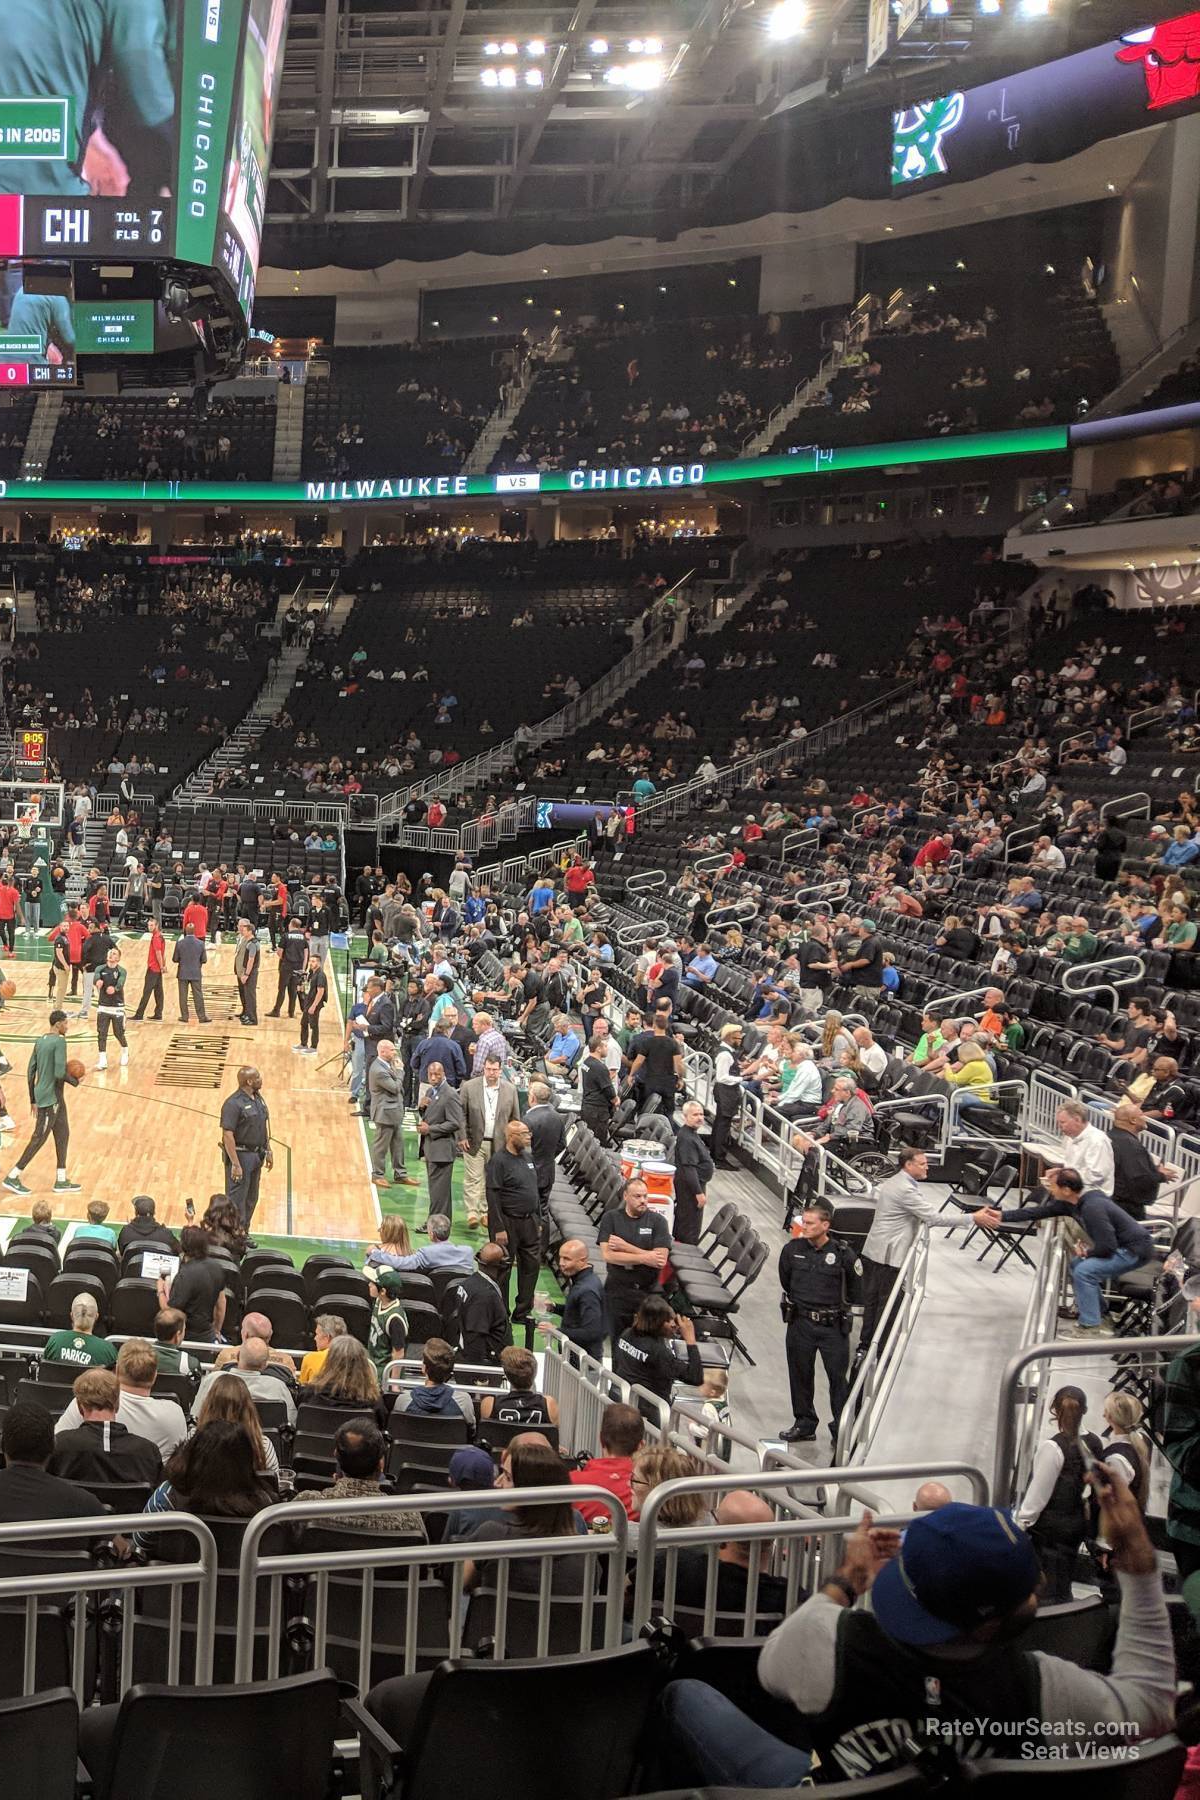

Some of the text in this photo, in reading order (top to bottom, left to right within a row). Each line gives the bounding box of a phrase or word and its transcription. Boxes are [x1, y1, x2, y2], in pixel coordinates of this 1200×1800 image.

[6, 127, 21, 143] IN
[24, 127, 61, 143] 2005
[190, 72, 216, 218] CHICAGO
[116, 210, 162, 225] TOL 7
[44, 208, 90, 243] CHI
[116, 228, 162, 243] FLS 0
[7, 368, 16, 380] 0
[34, 368, 50, 380] CHI
[307, 464, 704, 500] MILWAUKEE VS CHICAGO
[23, 732, 44, 743] 8:05
[27, 743, 41, 758] 12
[61, 1347, 92, 1365] PARKER
